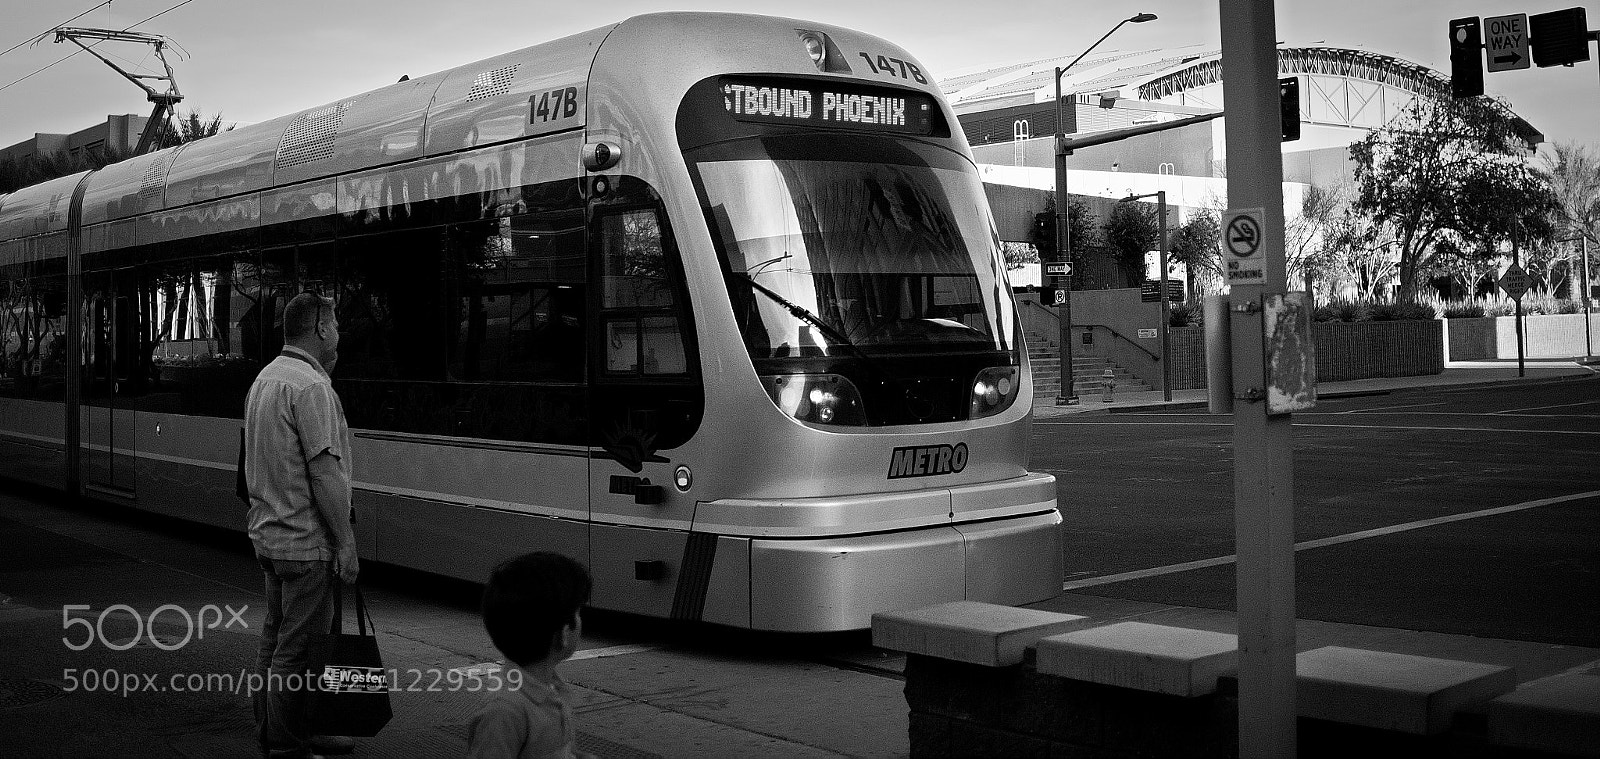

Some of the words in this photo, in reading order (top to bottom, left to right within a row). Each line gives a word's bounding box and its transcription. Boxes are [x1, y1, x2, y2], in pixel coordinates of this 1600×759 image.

[1490, 19, 1521, 35] ONE
[1490, 34, 1522, 51] WAY
[859, 51, 928, 85] 147B
[528, 87, 578, 125] 147B
[822, 91, 905, 126] PHOENIX
[1228, 261, 1240, 271] NO
[1228, 269, 1263, 280] SMOKING
[887, 442, 968, 479] METRO
[340, 669, 387, 684] Western
